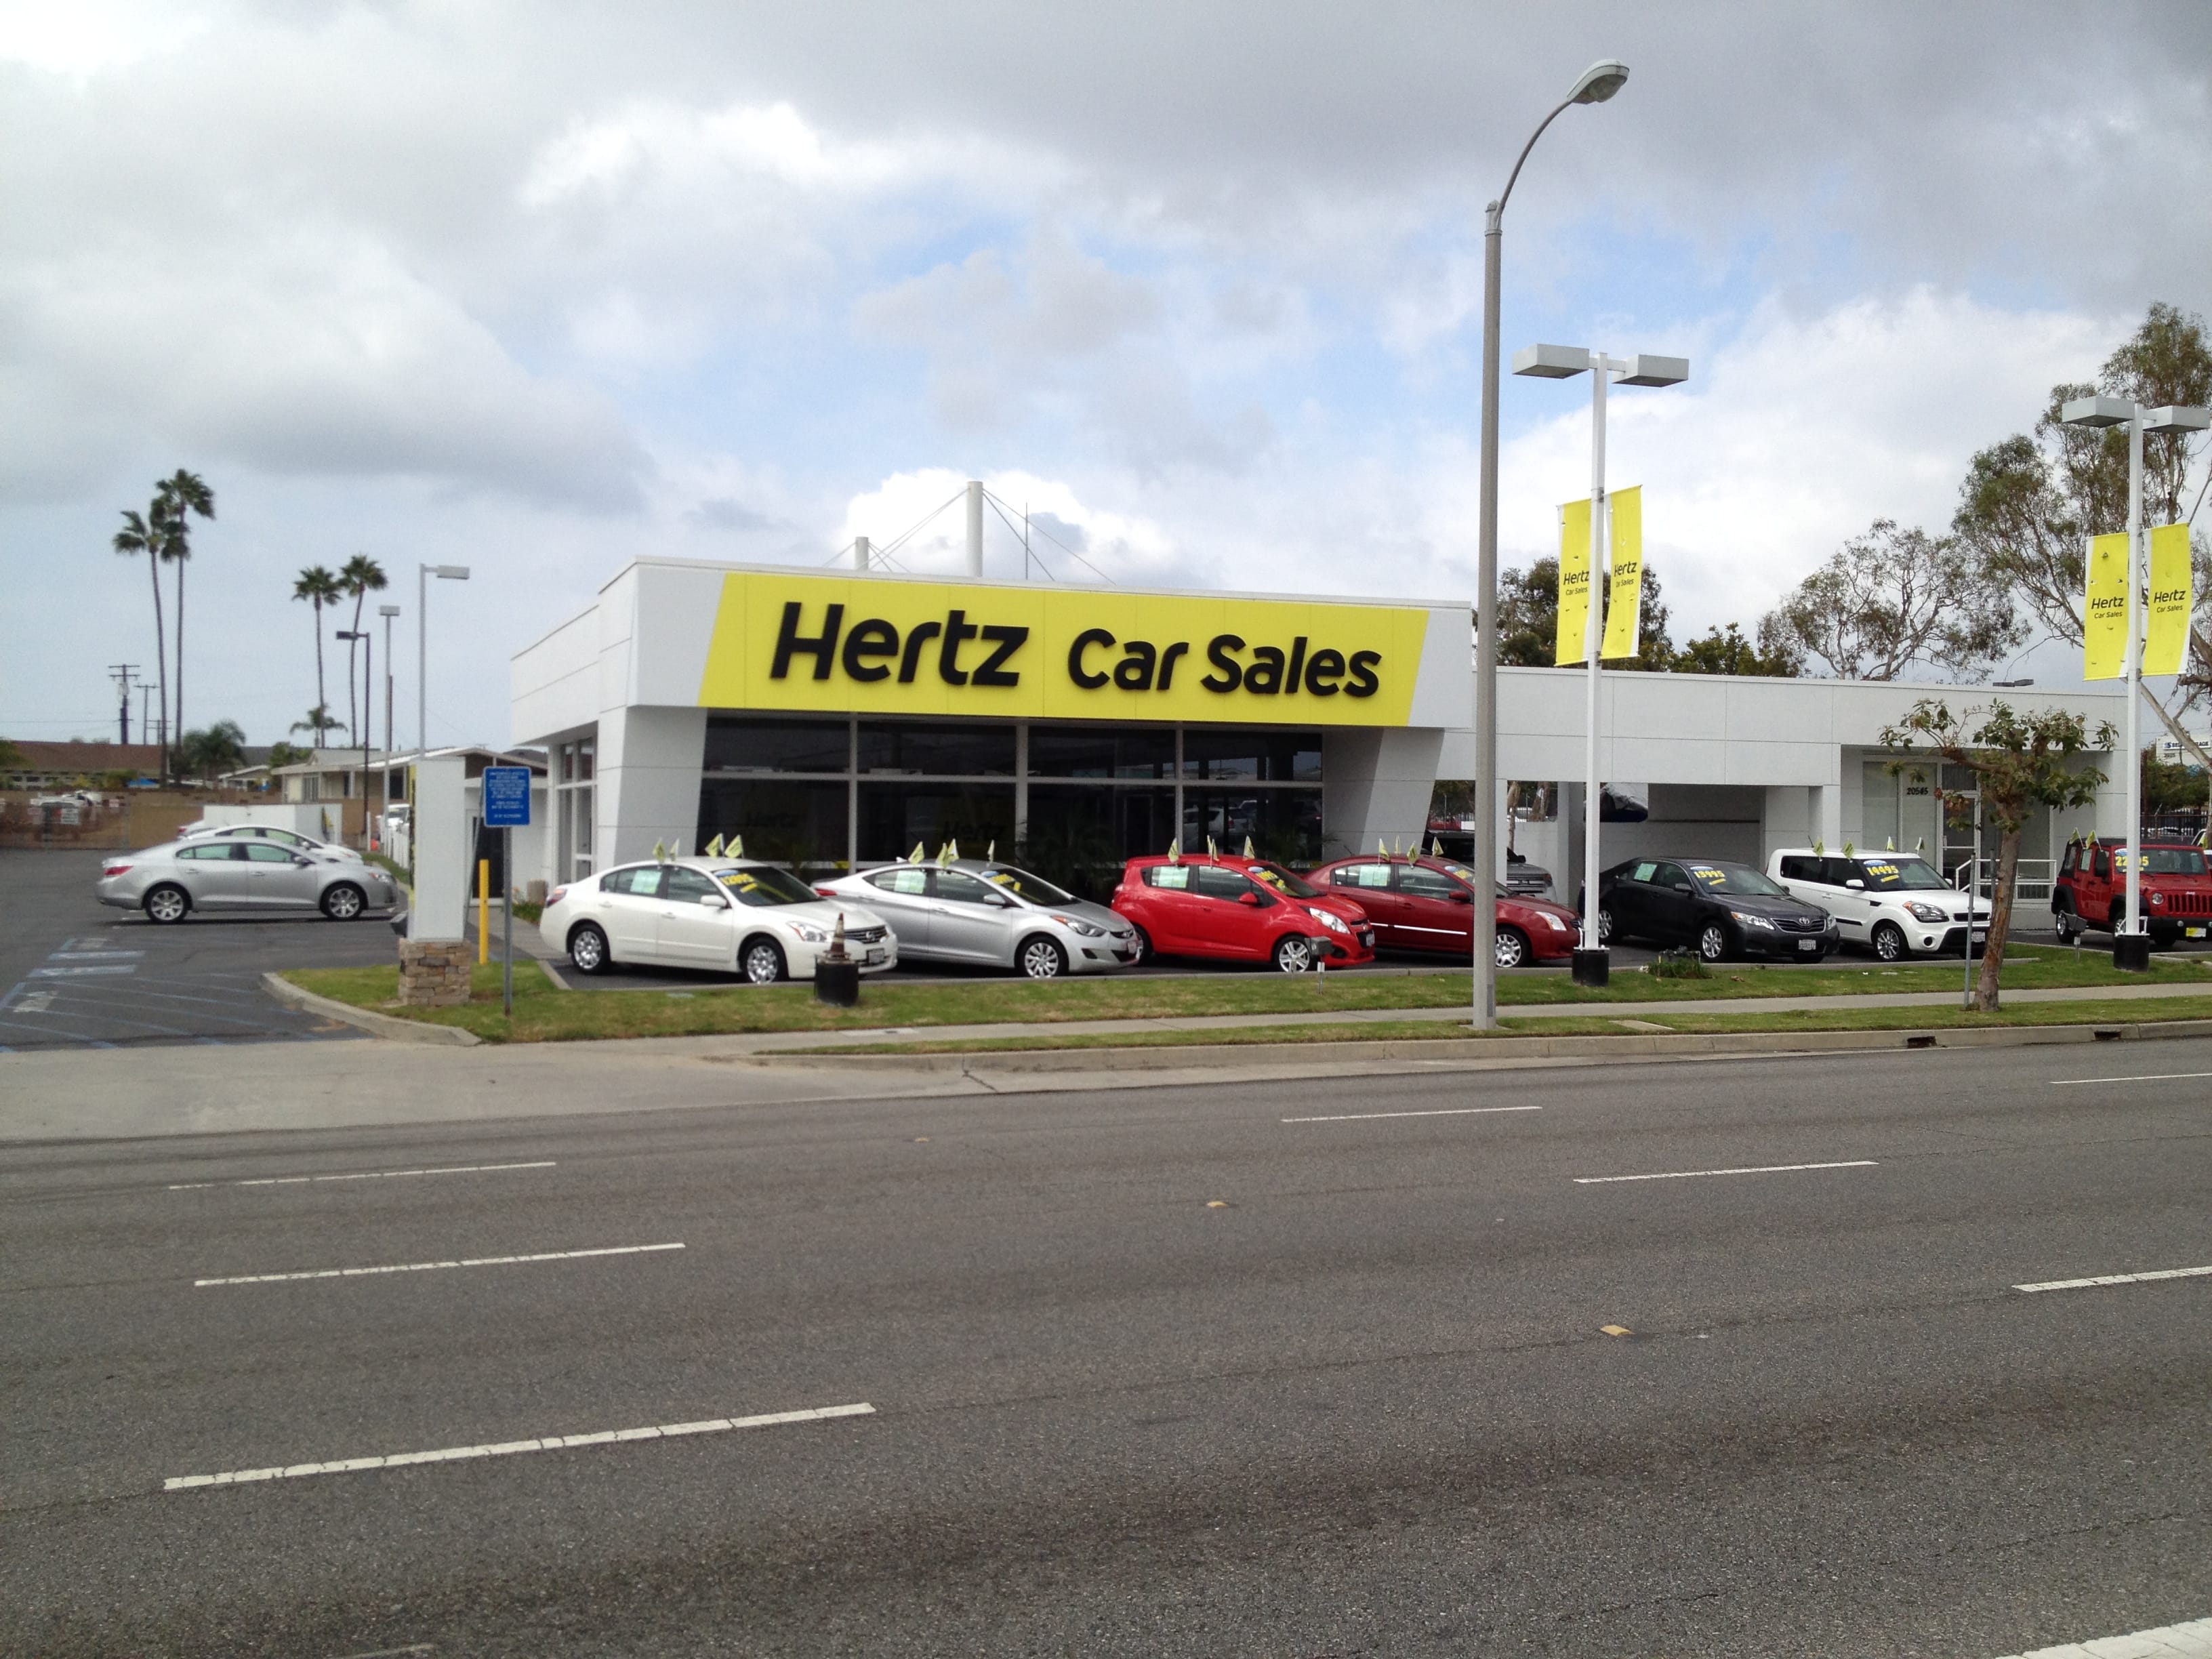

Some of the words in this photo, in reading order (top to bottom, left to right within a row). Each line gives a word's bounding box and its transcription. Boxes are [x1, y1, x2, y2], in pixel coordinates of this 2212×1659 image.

[1614, 561, 1637, 577] Hertz
[1563, 571, 1589, 586] Hertz
[2091, 596, 2124, 609] Hertz
[2154, 590, 2186, 603] Hertz
[771, 602, 1029, 688] Hertz
[1067, 628, 1189, 691] Car
[1200, 634, 1382, 699] Sales
[1906, 787, 1929, 796] 20545
[2115, 856, 2149, 867] 225
